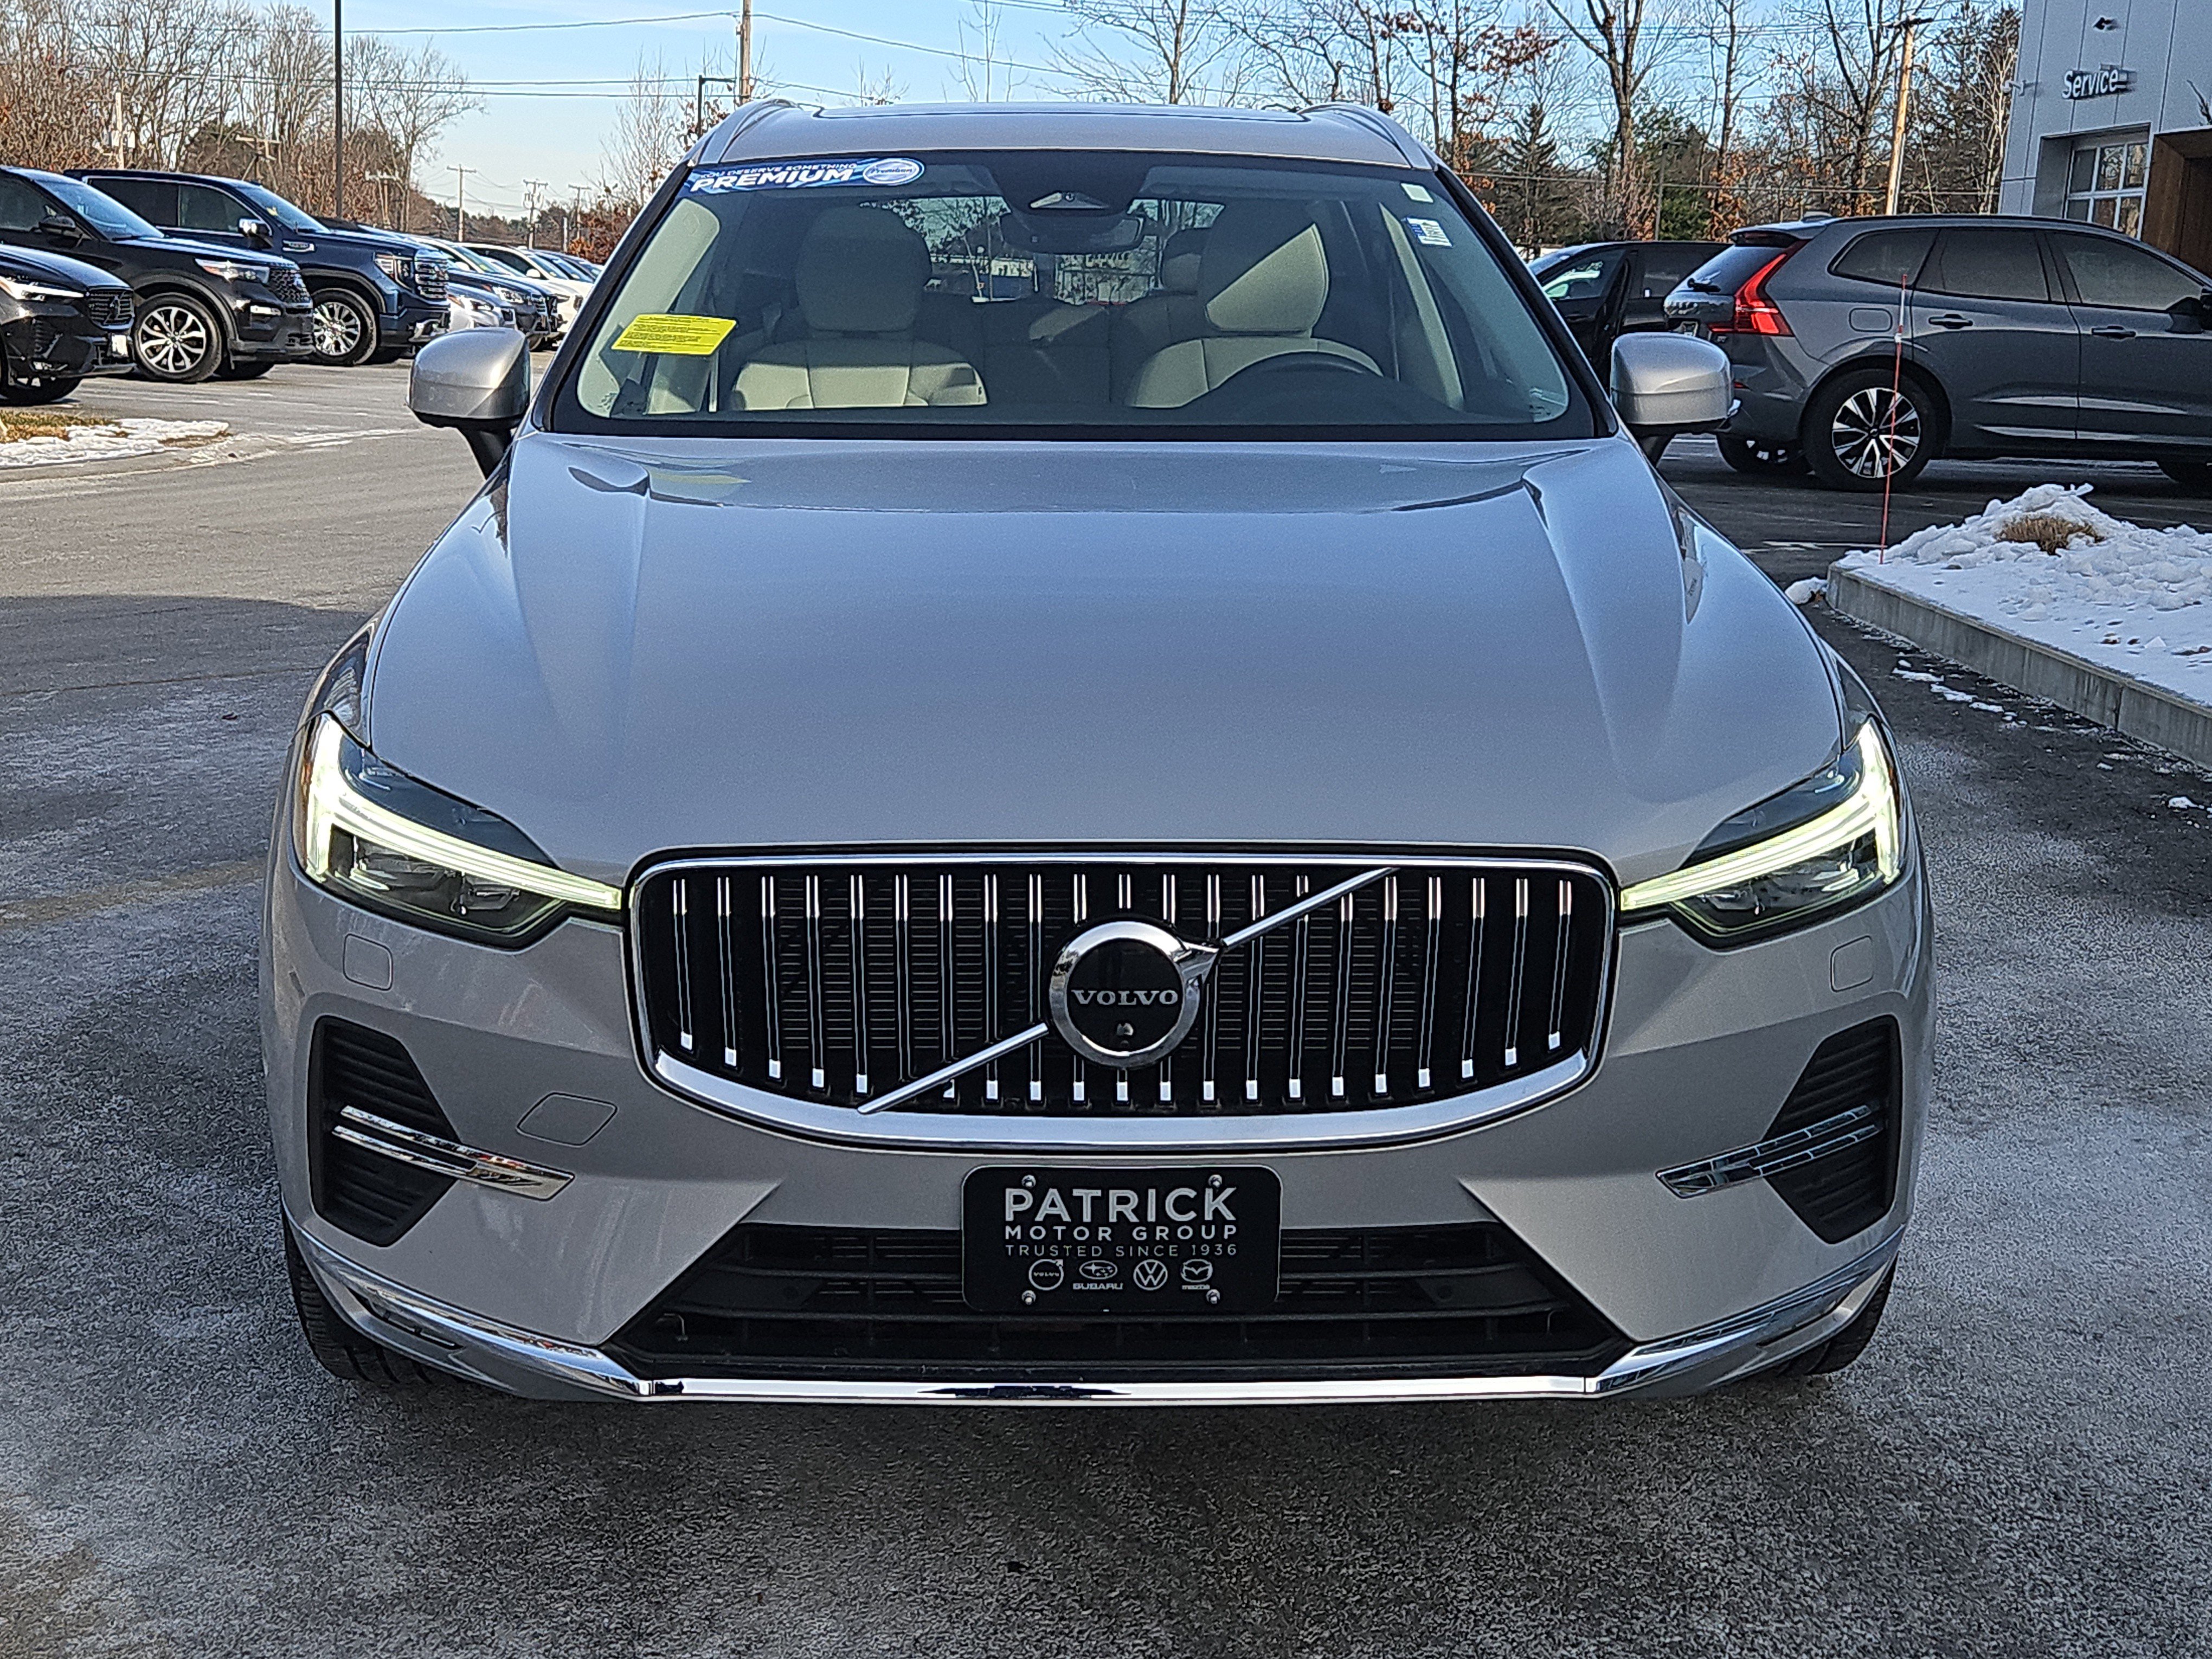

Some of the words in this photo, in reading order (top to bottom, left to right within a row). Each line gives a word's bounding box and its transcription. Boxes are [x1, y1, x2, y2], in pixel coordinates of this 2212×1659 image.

[2062, 69, 2119, 99] Service
[690, 169, 854, 192] PREMIUM
[1071, 989, 1178, 1005] VOLVO
[1005, 1187, 1237, 1223] PATRICK
[1005, 1225, 1111, 1242] MOTOR
[1132, 1225, 1237, 1241] GROUP
[1006, 1245, 1102, 1257] TRUSTED
[1116, 1245, 1178, 1257] SINCE
[1192, 1244, 1237, 1256] 1936
